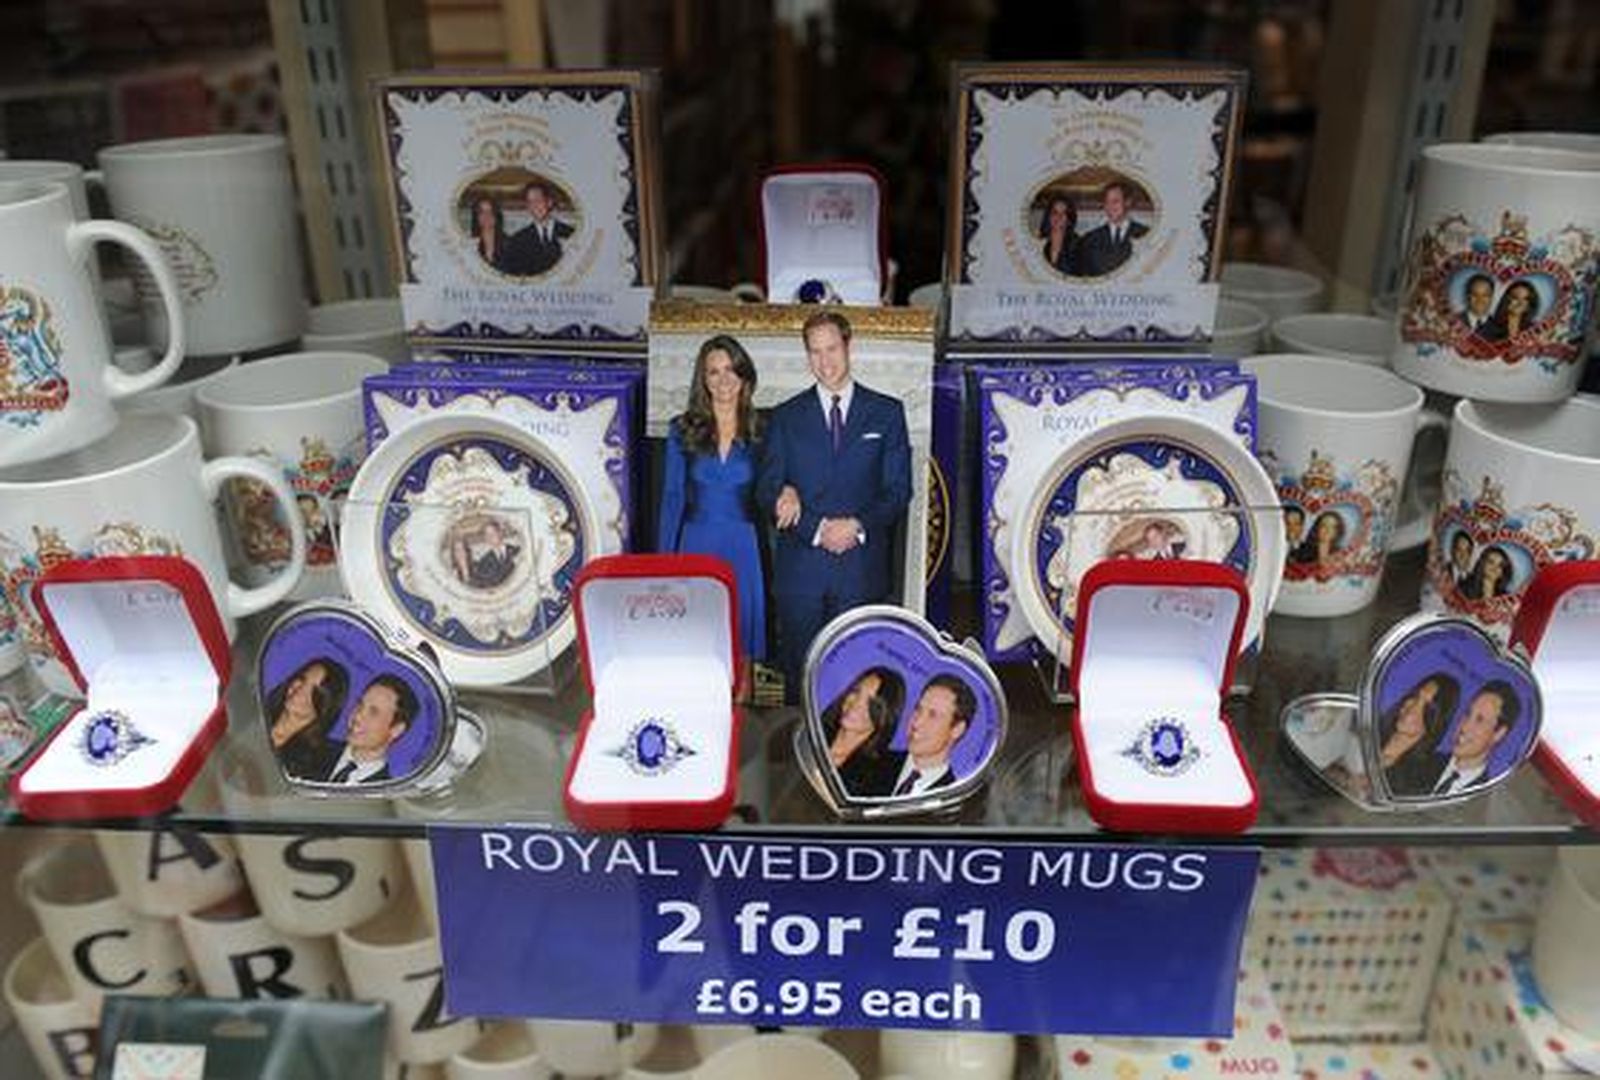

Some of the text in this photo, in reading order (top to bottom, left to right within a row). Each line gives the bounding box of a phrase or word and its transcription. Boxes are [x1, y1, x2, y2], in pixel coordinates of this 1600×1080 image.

[283, 833, 355, 901] S
[481, 833, 1208, 891] ROYAL WEDDING MUGS
[73, 930, 146, 989] C
[656, 900, 1056, 962] 2 for £10
[229, 946, 304, 999] R
[696, 979, 982, 1021] £6.95 each
